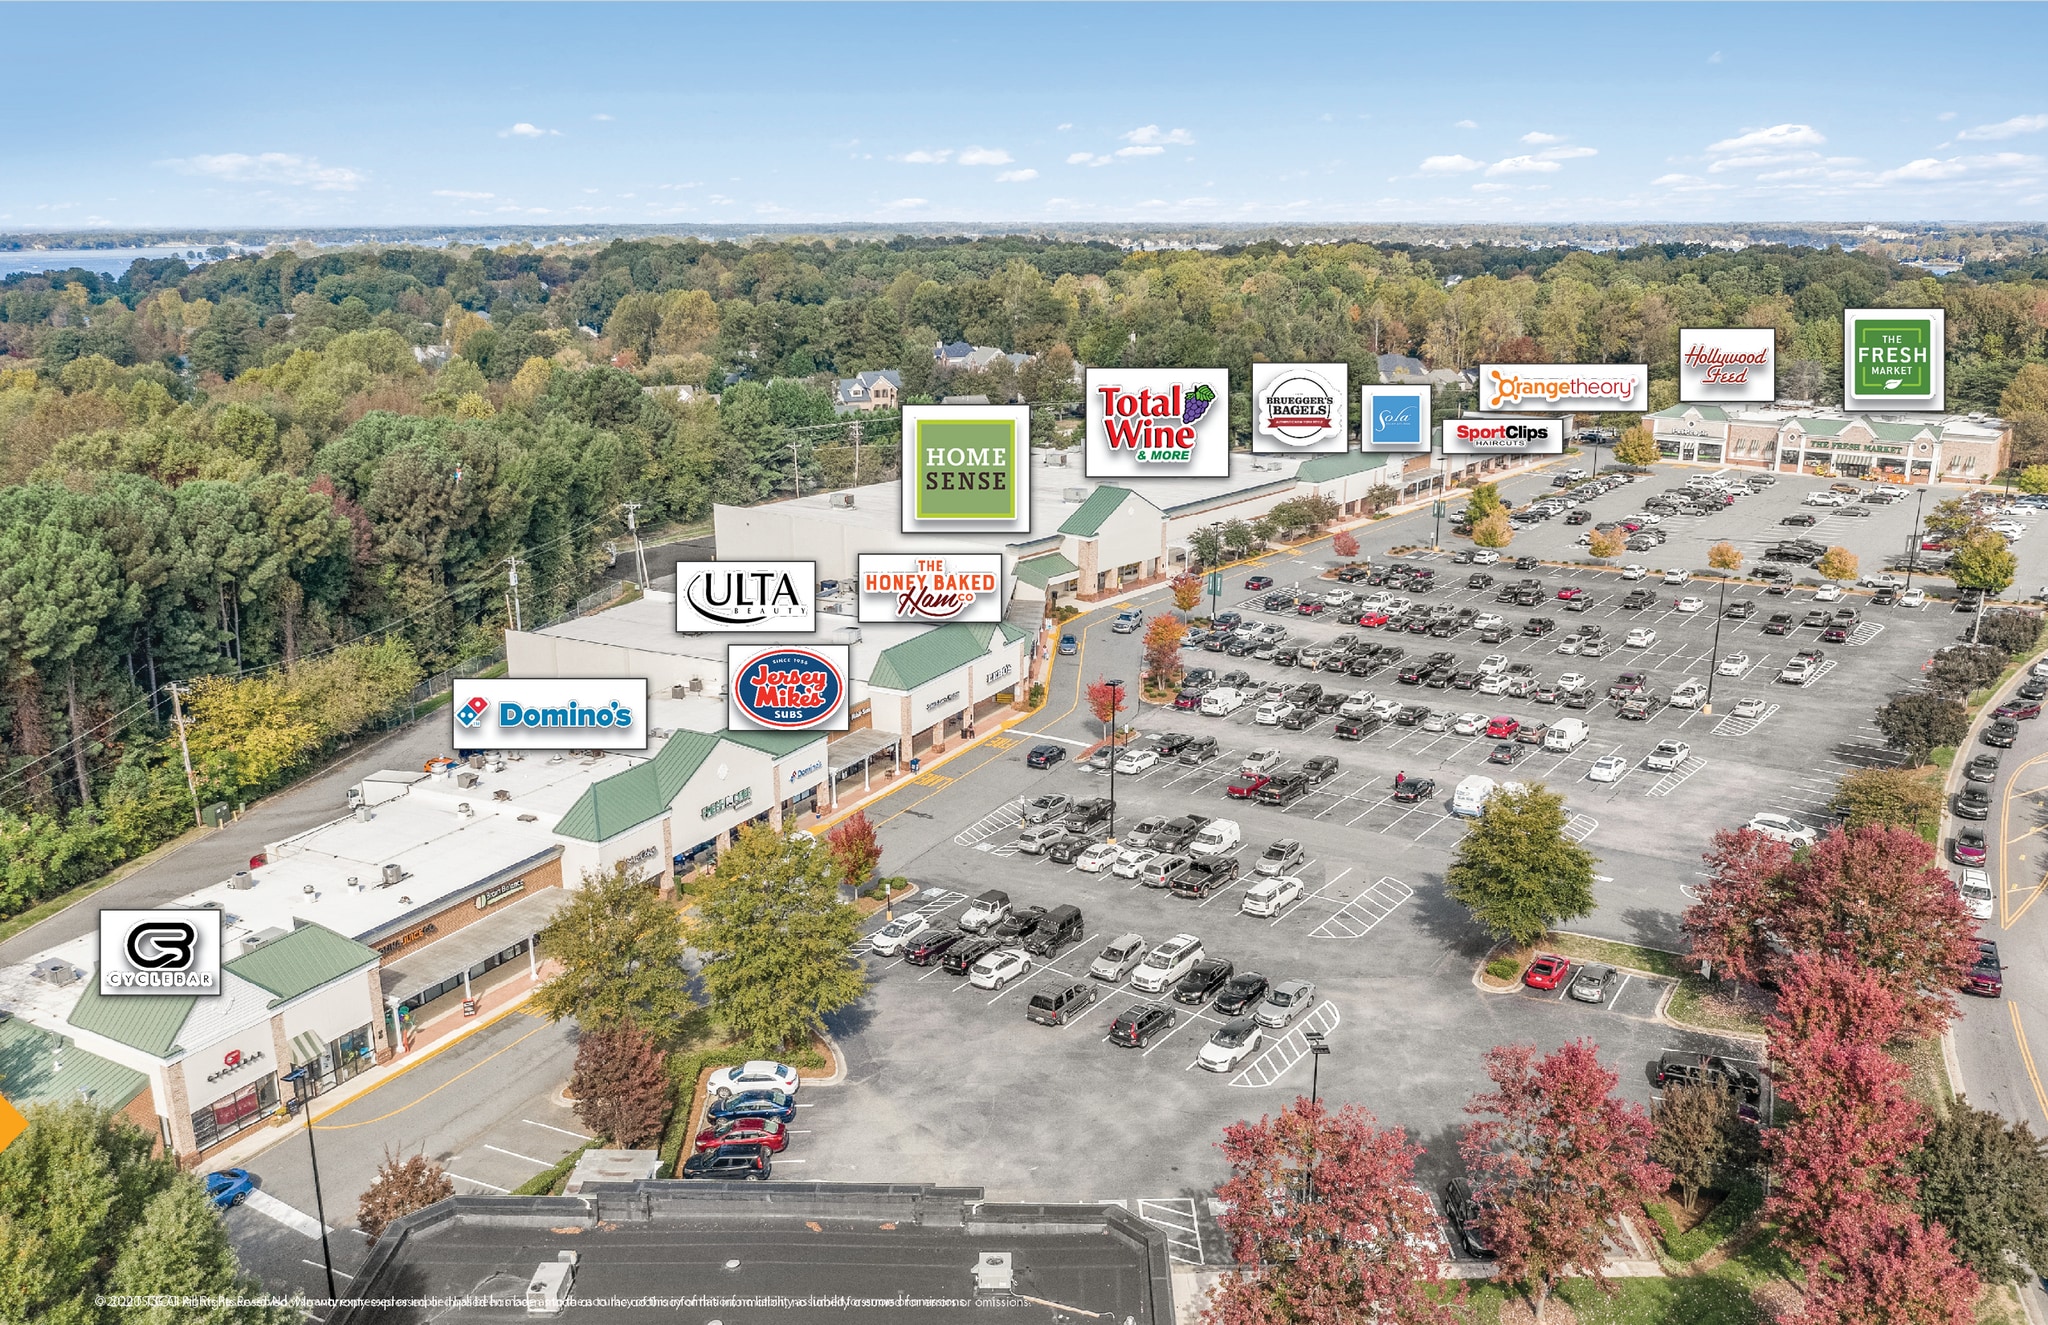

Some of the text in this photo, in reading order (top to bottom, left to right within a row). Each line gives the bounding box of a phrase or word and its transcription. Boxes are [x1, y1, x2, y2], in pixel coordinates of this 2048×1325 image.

[1810, 440, 1903, 454] THE FRESH MARKET
[402, 928, 424, 946] JUICE
